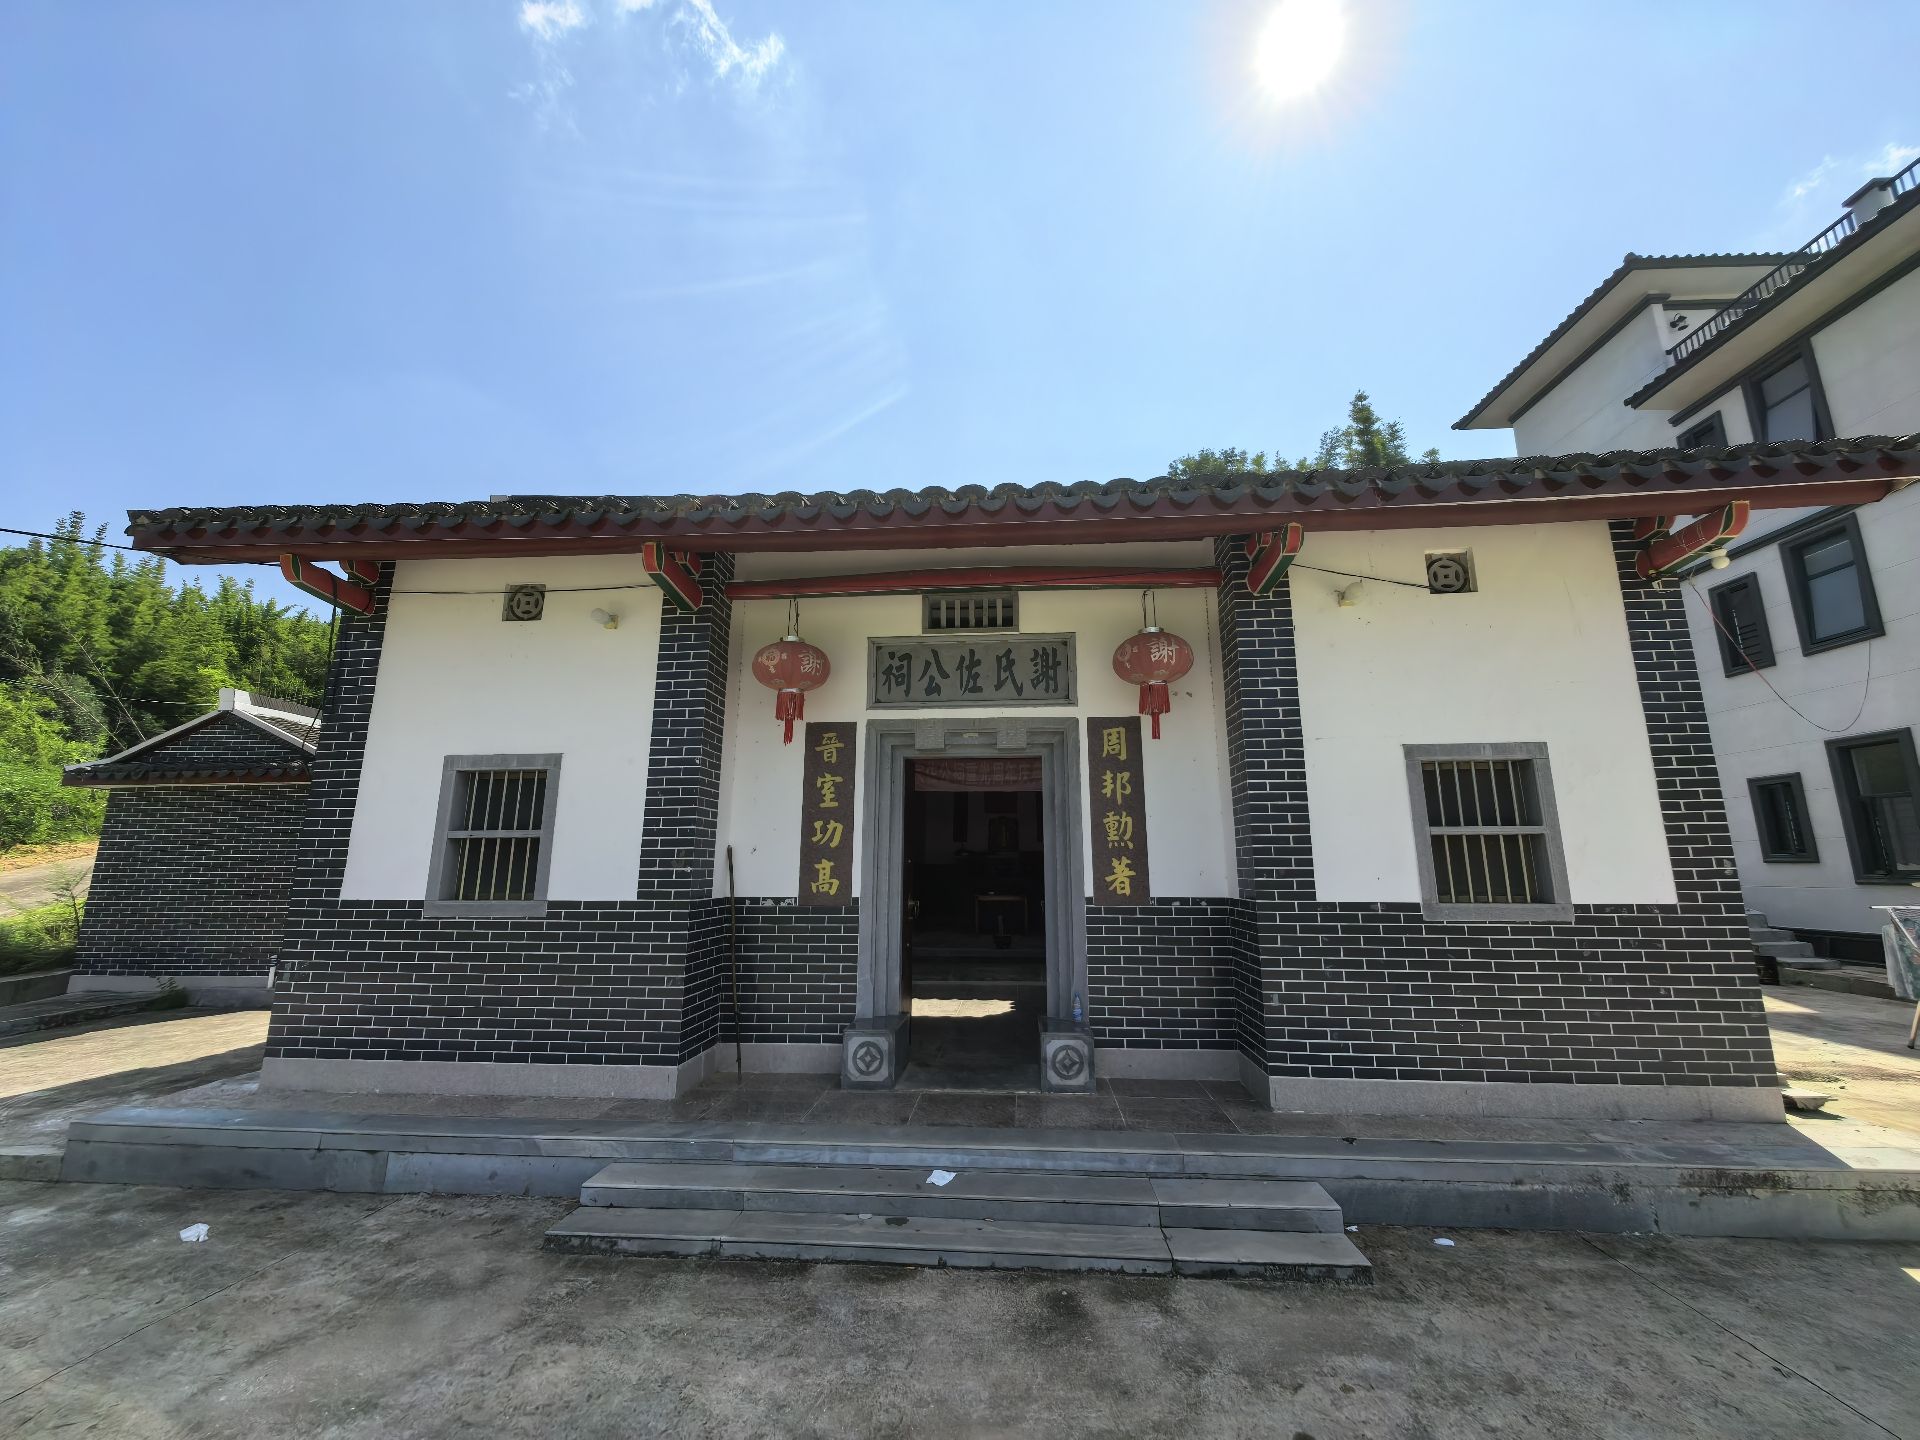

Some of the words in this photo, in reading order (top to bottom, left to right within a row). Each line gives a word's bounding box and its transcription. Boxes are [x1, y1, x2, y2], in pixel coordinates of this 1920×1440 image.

[881, 647, 1062, 698] 謝氏佐公祠
[1102, 727, 1136, 897] 周邦勳著
